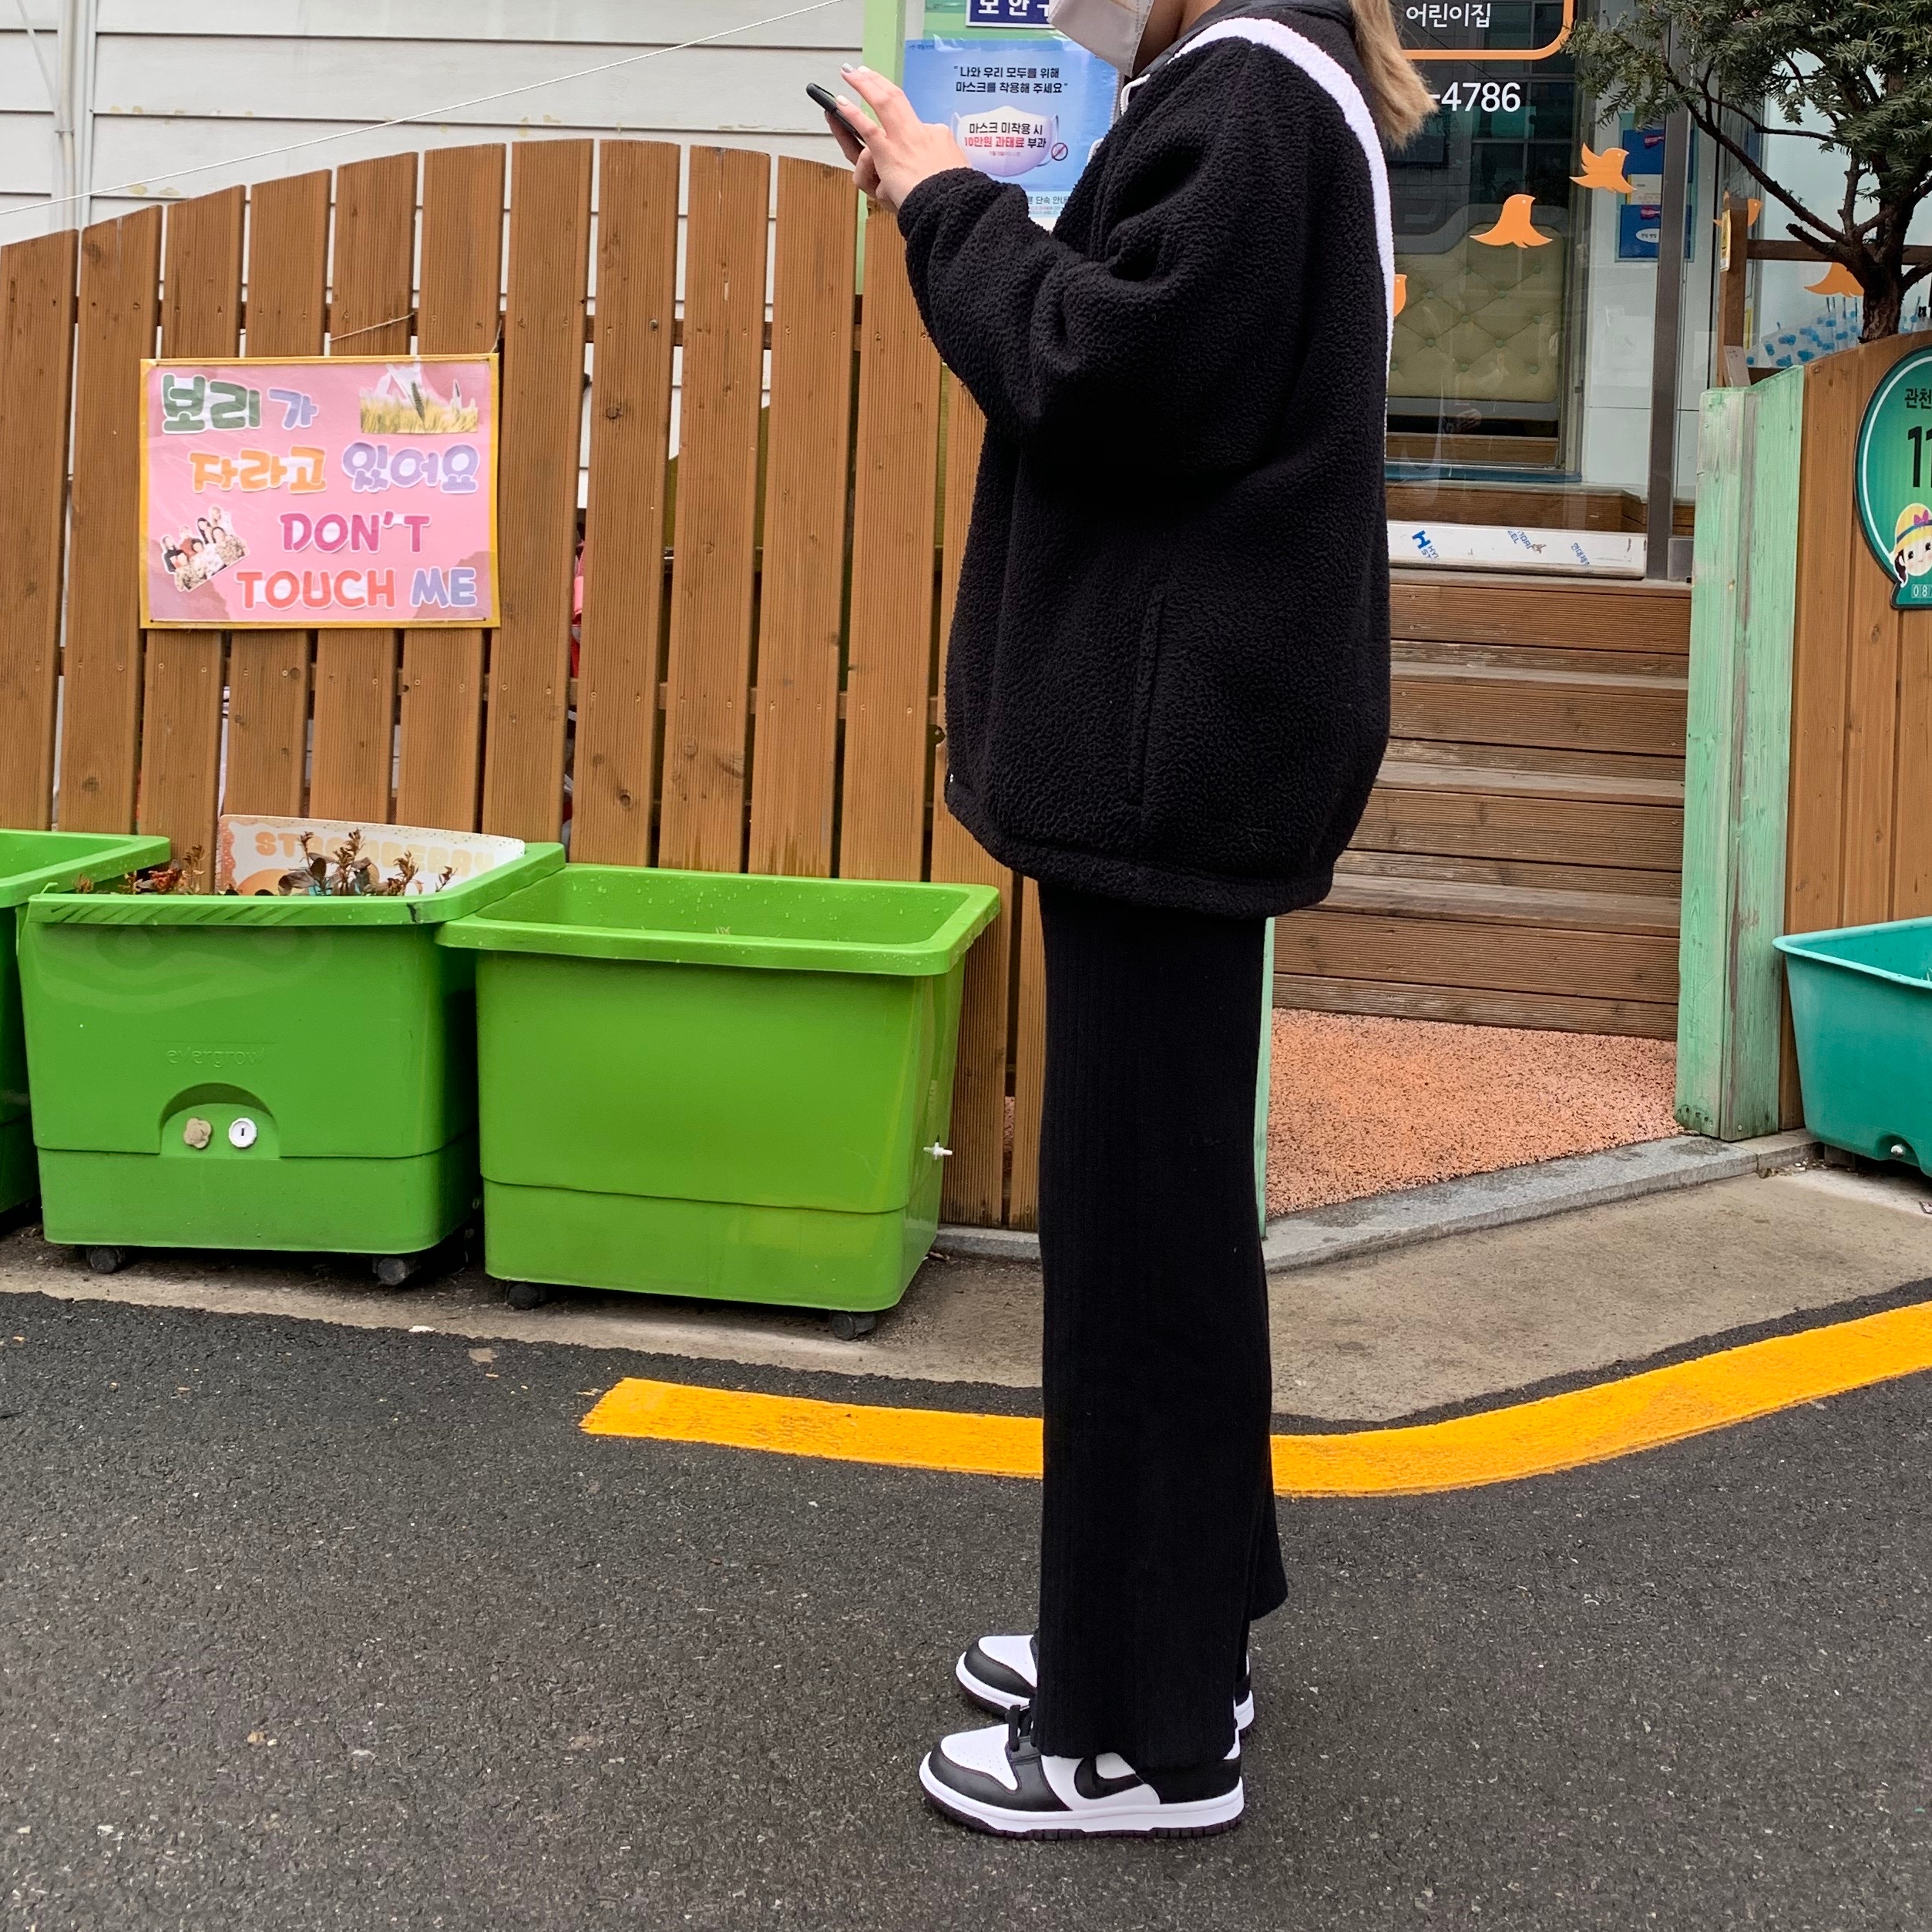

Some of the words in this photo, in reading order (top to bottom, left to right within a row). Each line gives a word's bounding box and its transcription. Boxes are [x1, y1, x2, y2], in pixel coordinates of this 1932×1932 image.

[978, 0, 1050, 16] 보안
[1406, 3, 1491, 28] 어린이집
[983, 67, 1003, 78] 우리
[1006, 67, 1037, 79] 모두를
[1040, 68, 1060, 78] 위해
[956, 82, 996, 93] 마스크를
[1000, 82, 1030, 93] 착용해
[969, 123, 998, 133] 마스크
[1001, 123, 1030, 135] 미착용
[1033, 124, 1043, 135] 시
[964, 136, 993, 147] 10만원
[995, 136, 1025, 148] 과태료
[1027, 137, 1047, 148] 부과
[1036, 196, 1050, 204] 단속
[189, 446, 327, 493] 자라고
[342, 442, 479, 493] 있어요
[279, 512, 431, 553] DON'T
[236, 569, 395, 610] TOUCH
[411, 568, 478, 608] ME
[1913, 584, 1932, 597] 08
[166, 1047, 265, 1068] evergrow
